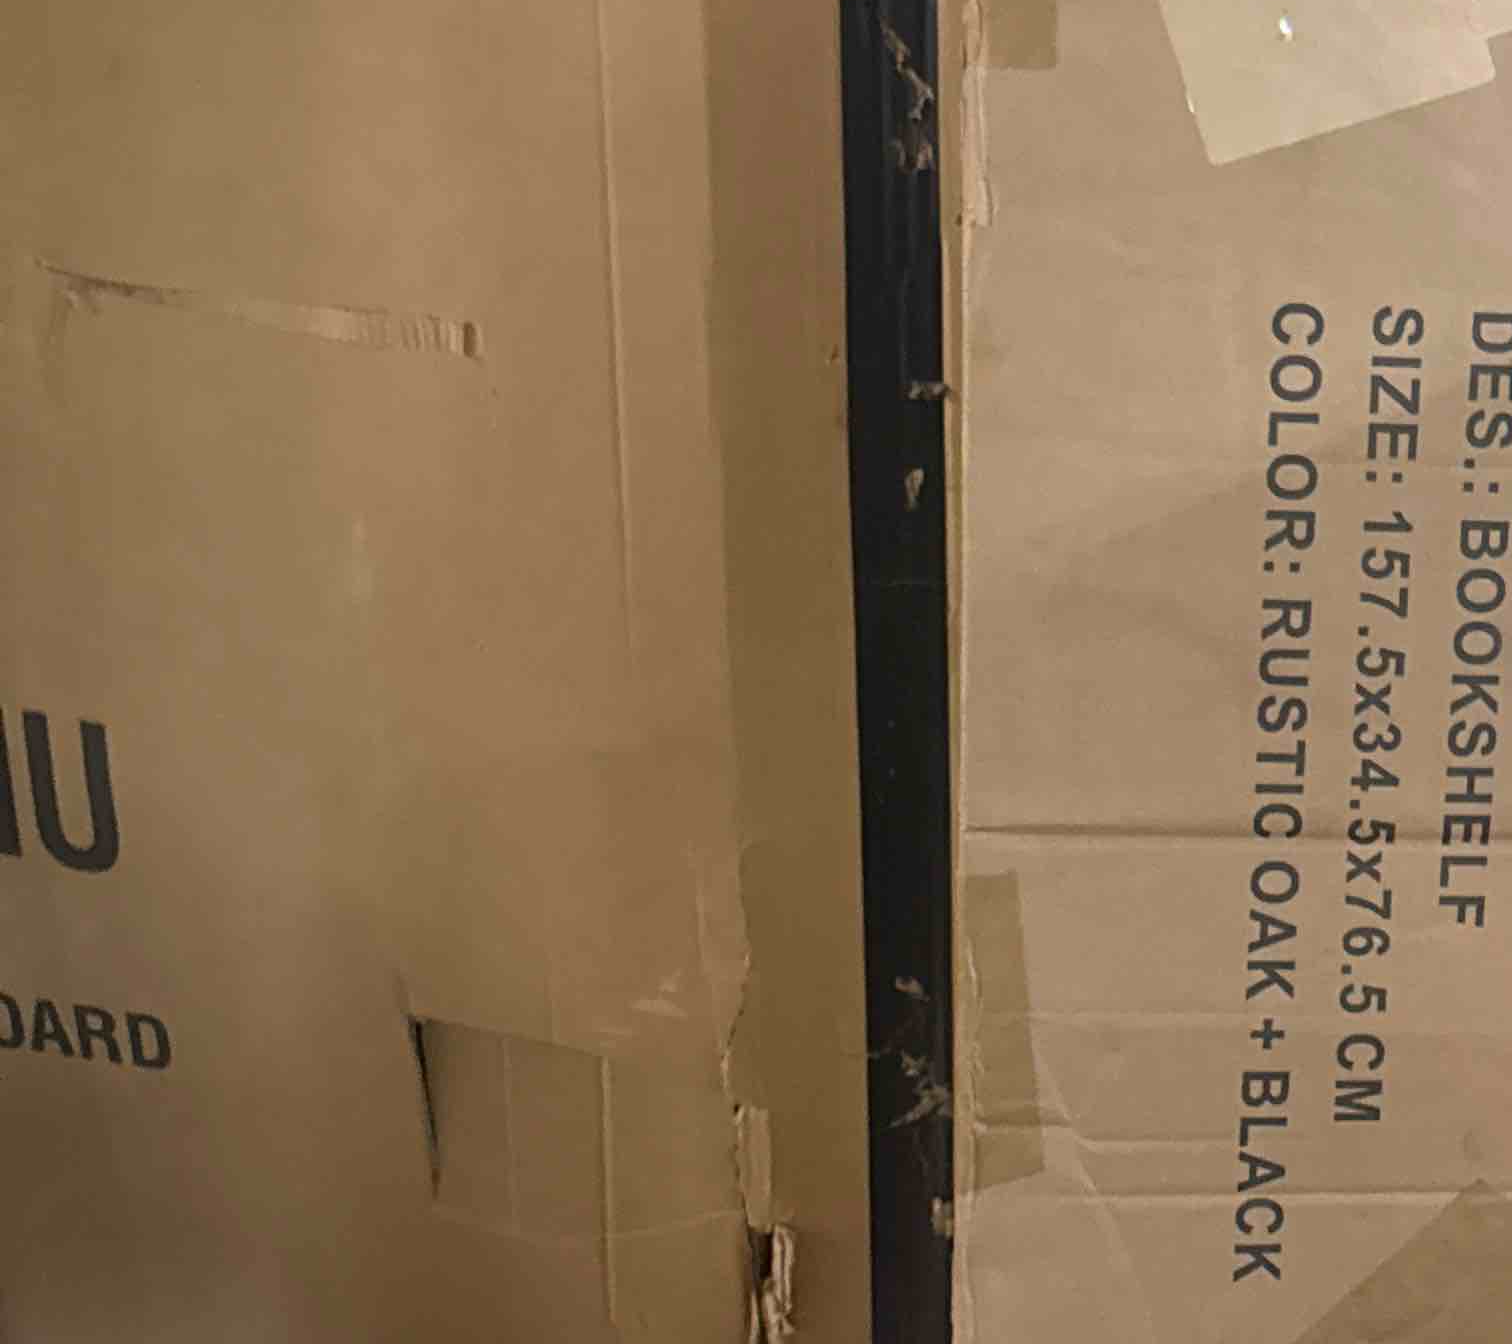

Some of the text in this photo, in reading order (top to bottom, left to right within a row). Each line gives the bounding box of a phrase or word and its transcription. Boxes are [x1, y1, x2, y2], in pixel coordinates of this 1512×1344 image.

[0, 705, 120, 873] U
[1232, 302, 1325, 1283] COLOR: RUSTIC OAK + BLACK
[1333, 305, 1425, 1122] SIZE: 157.5x34.5x76.5 CM
[1438, 519, 1510, 928] BOOKSHELF
